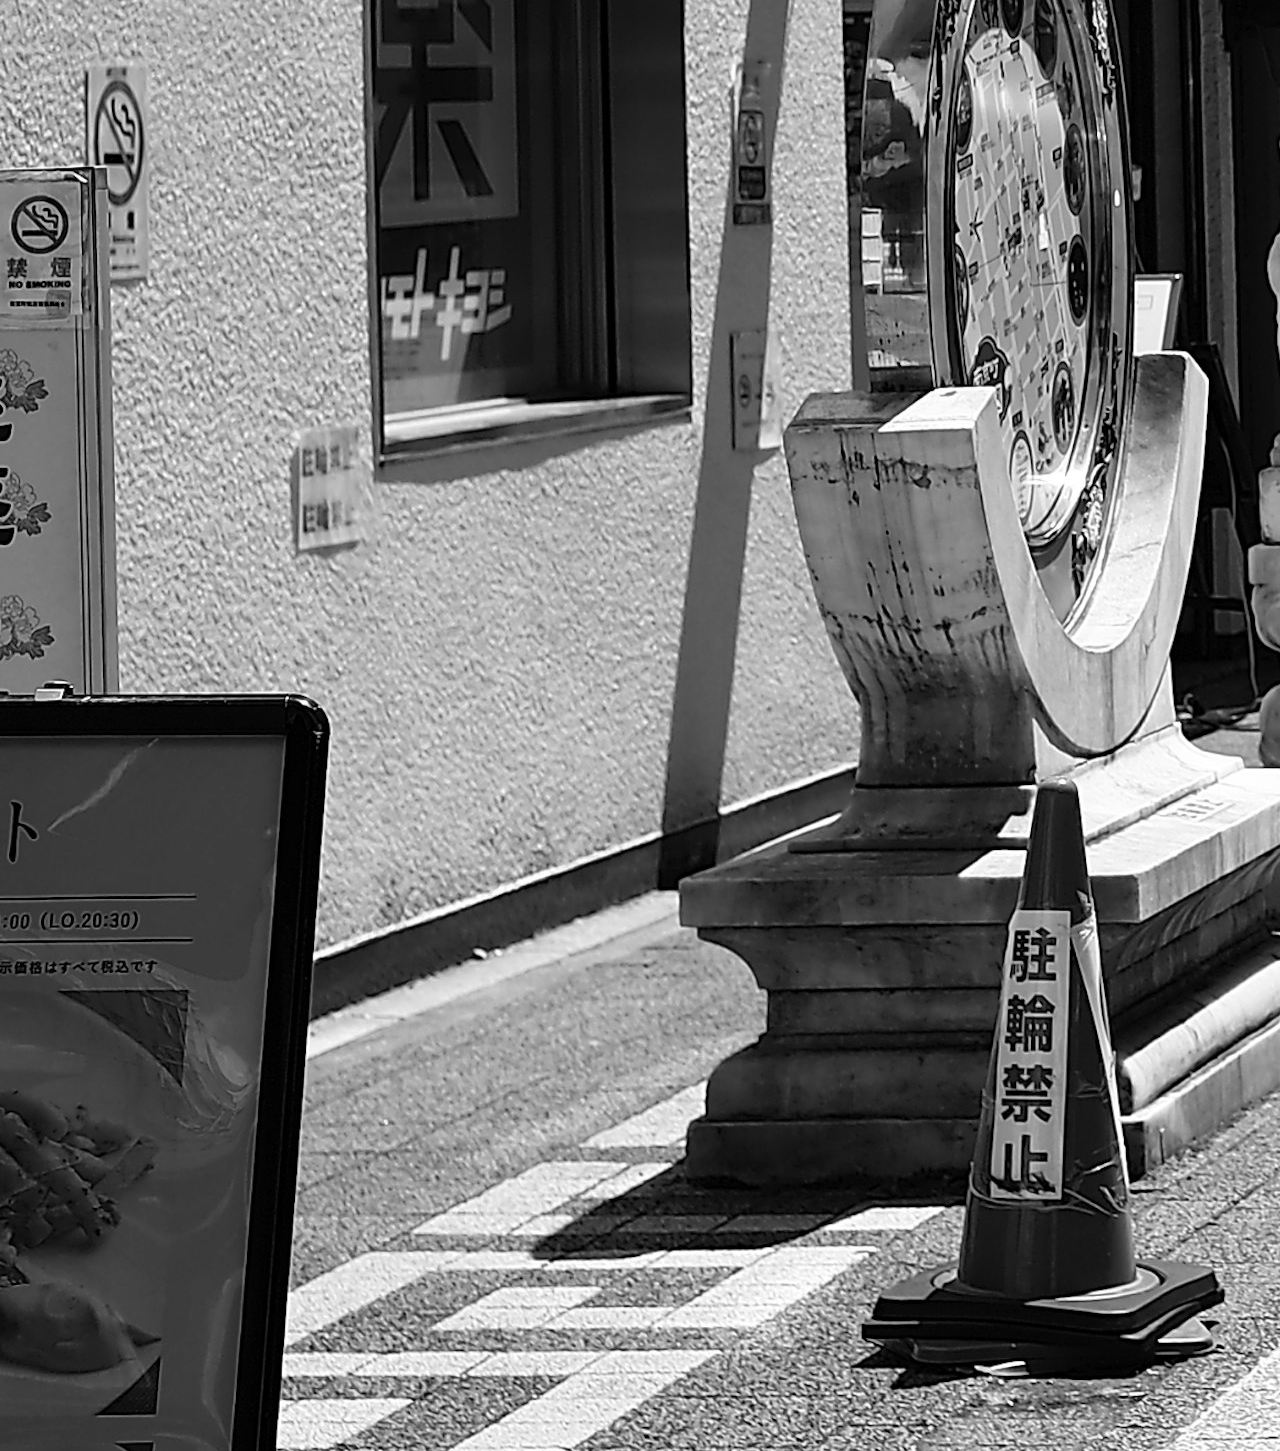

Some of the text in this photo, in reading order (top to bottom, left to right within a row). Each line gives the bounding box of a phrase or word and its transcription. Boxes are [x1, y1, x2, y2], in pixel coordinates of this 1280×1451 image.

[7, 256, 72, 279] 禁煙
[8, 279, 72, 289] NO SMOKING
[1001, 927, 1057, 1195] 駐輪禁止
